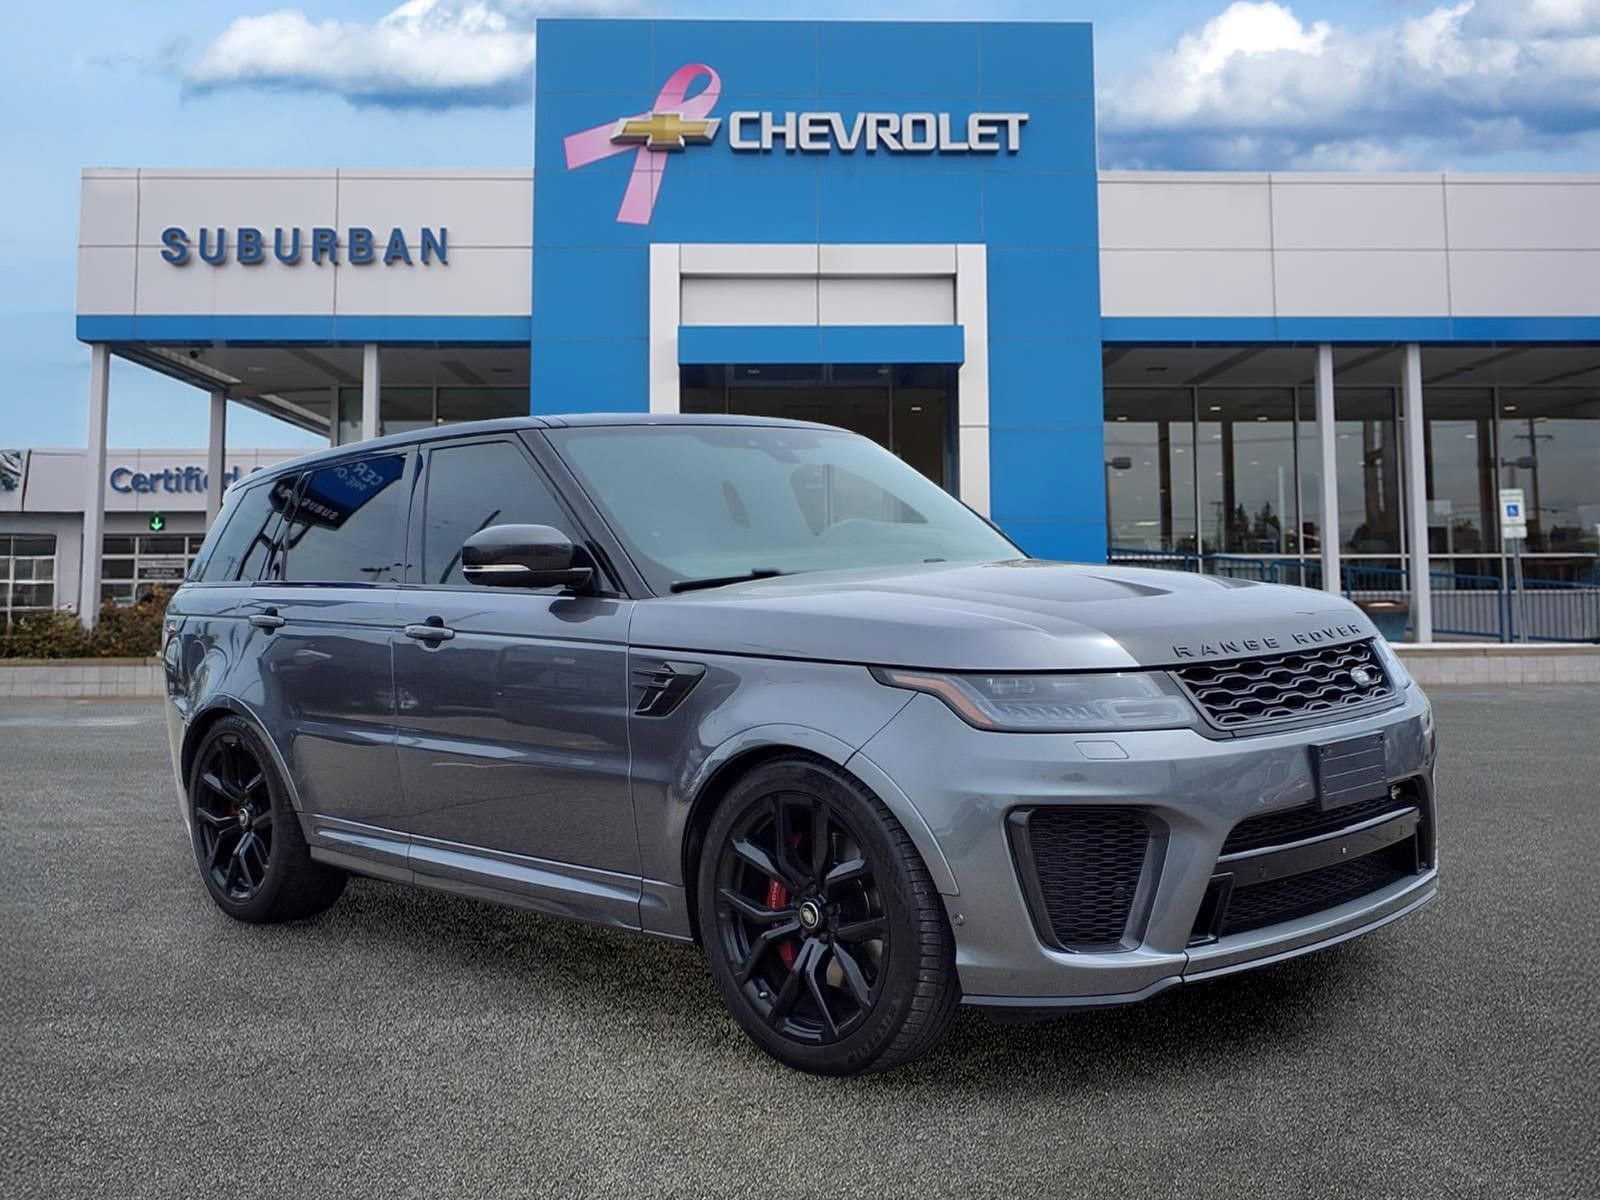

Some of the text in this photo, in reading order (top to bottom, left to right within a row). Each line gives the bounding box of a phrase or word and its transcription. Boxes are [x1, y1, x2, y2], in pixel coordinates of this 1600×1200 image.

[728, 111, 1029, 151] CHEVROLET
[160, 227, 449, 266] SUBURBAN
[1173, 623, 1361, 658] RANGE ROVER
